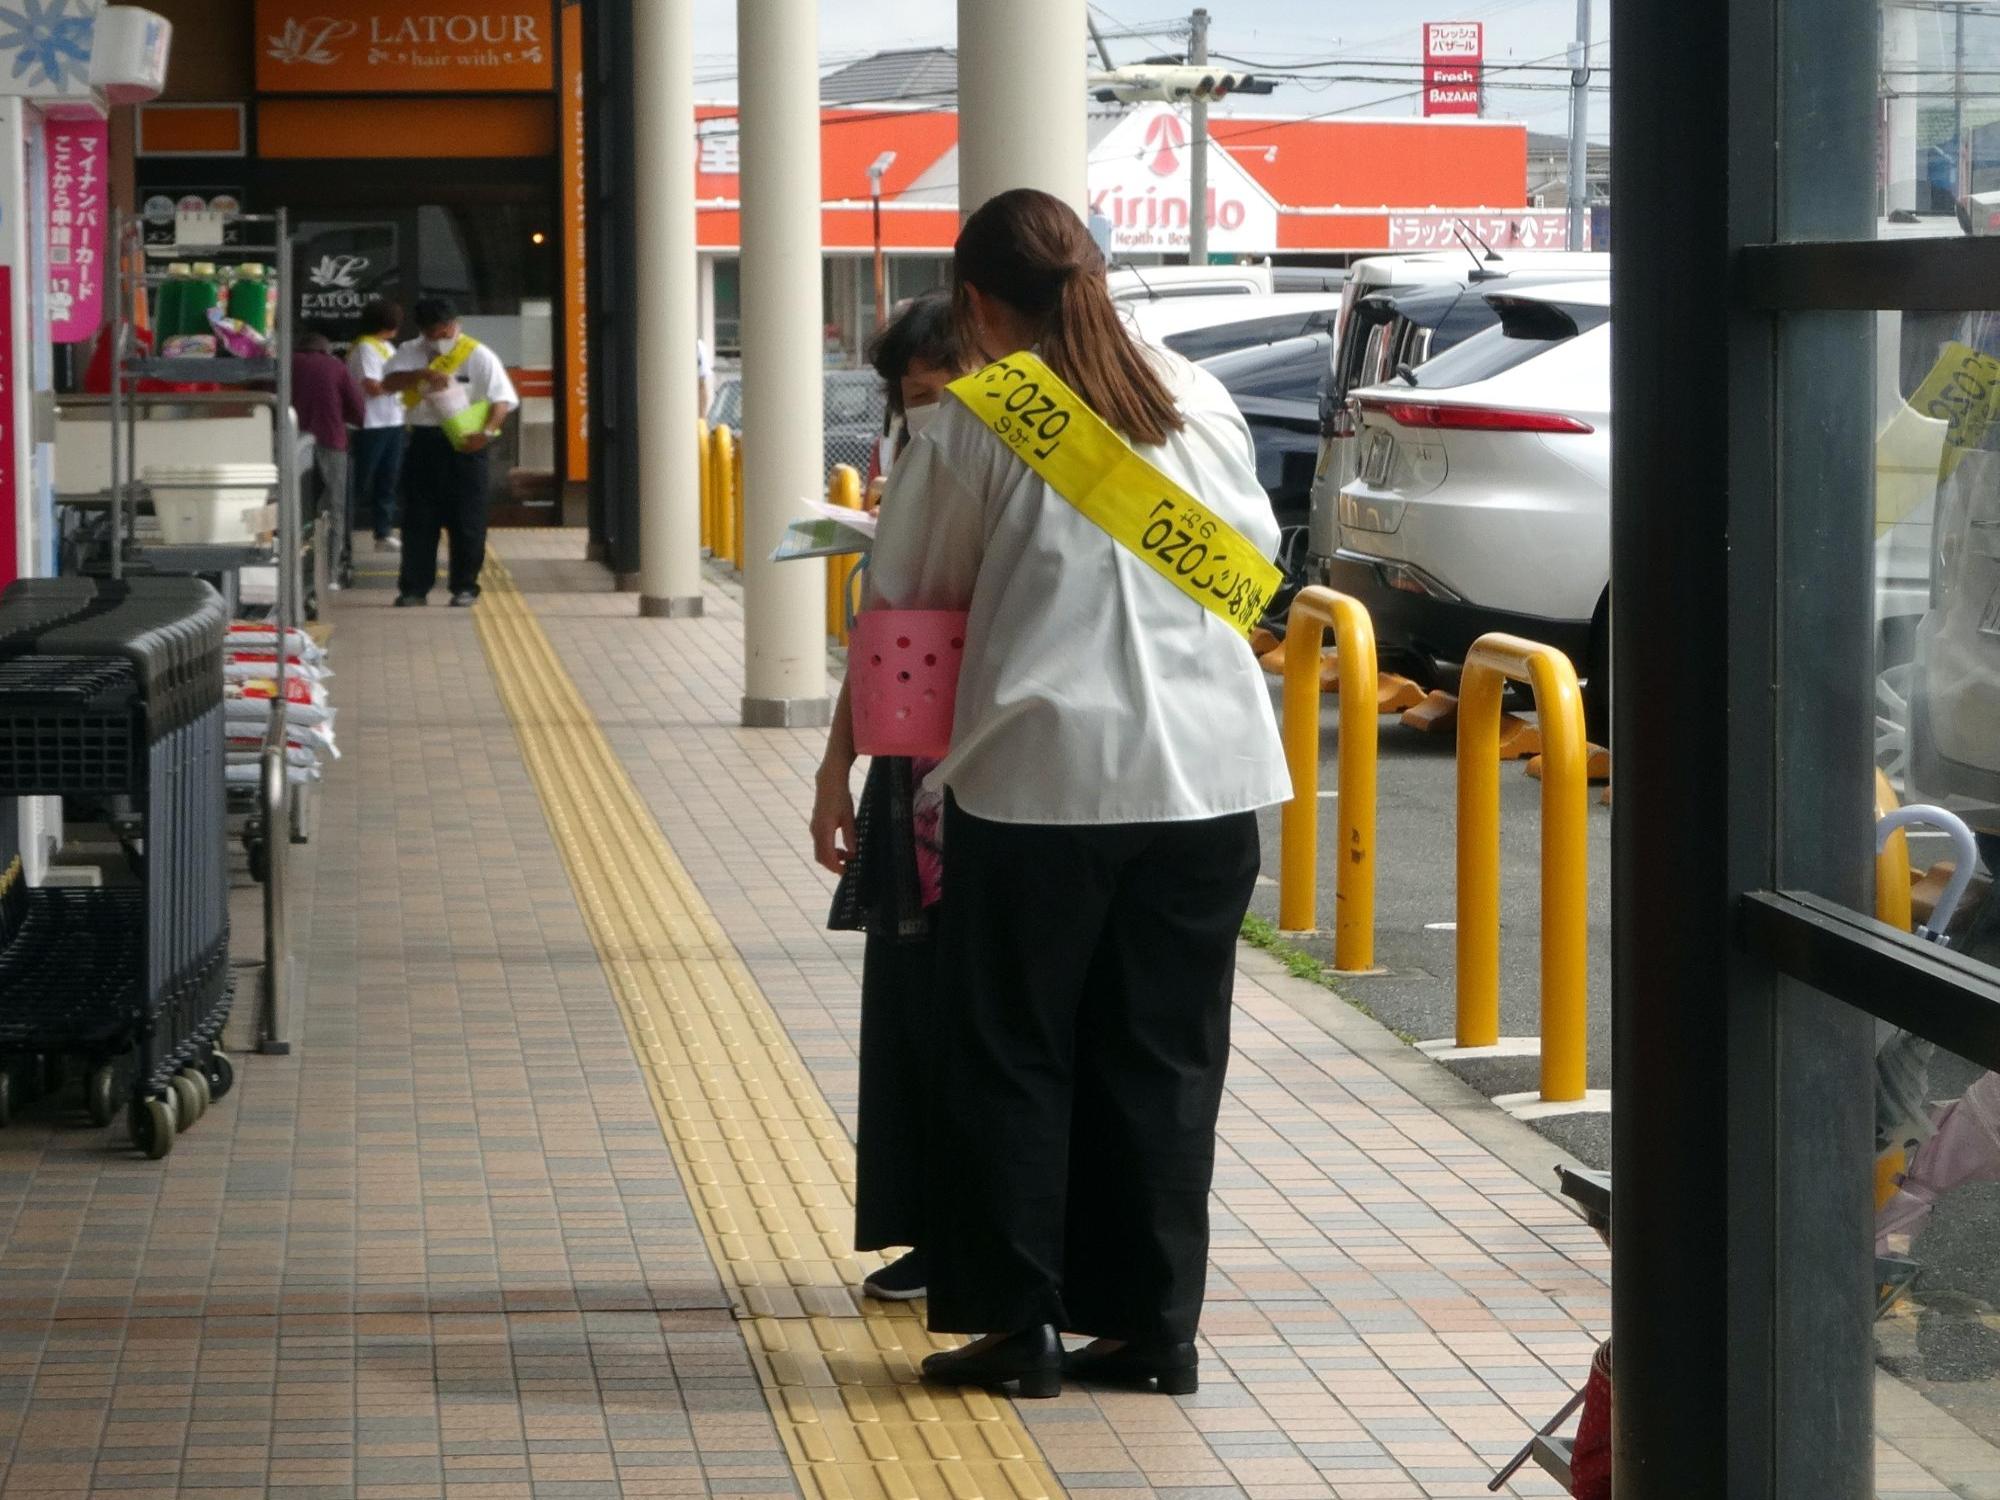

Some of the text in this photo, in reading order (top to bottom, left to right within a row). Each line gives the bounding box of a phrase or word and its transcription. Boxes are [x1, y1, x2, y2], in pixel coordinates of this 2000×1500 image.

[370, 15, 541, 43] LATOUR
[1430, 28, 1477, 39] フレッシュ
[1432, 40, 1475, 51] バザール
[411, 51, 499, 66] hair with
[1433, 70, 1473, 82] Fresh
[1429, 88, 1478, 103] BAZAAR
[75, 136, 98, 301] マイナンバーカード
[1388, 217, 1506, 247] ドラッグストア
